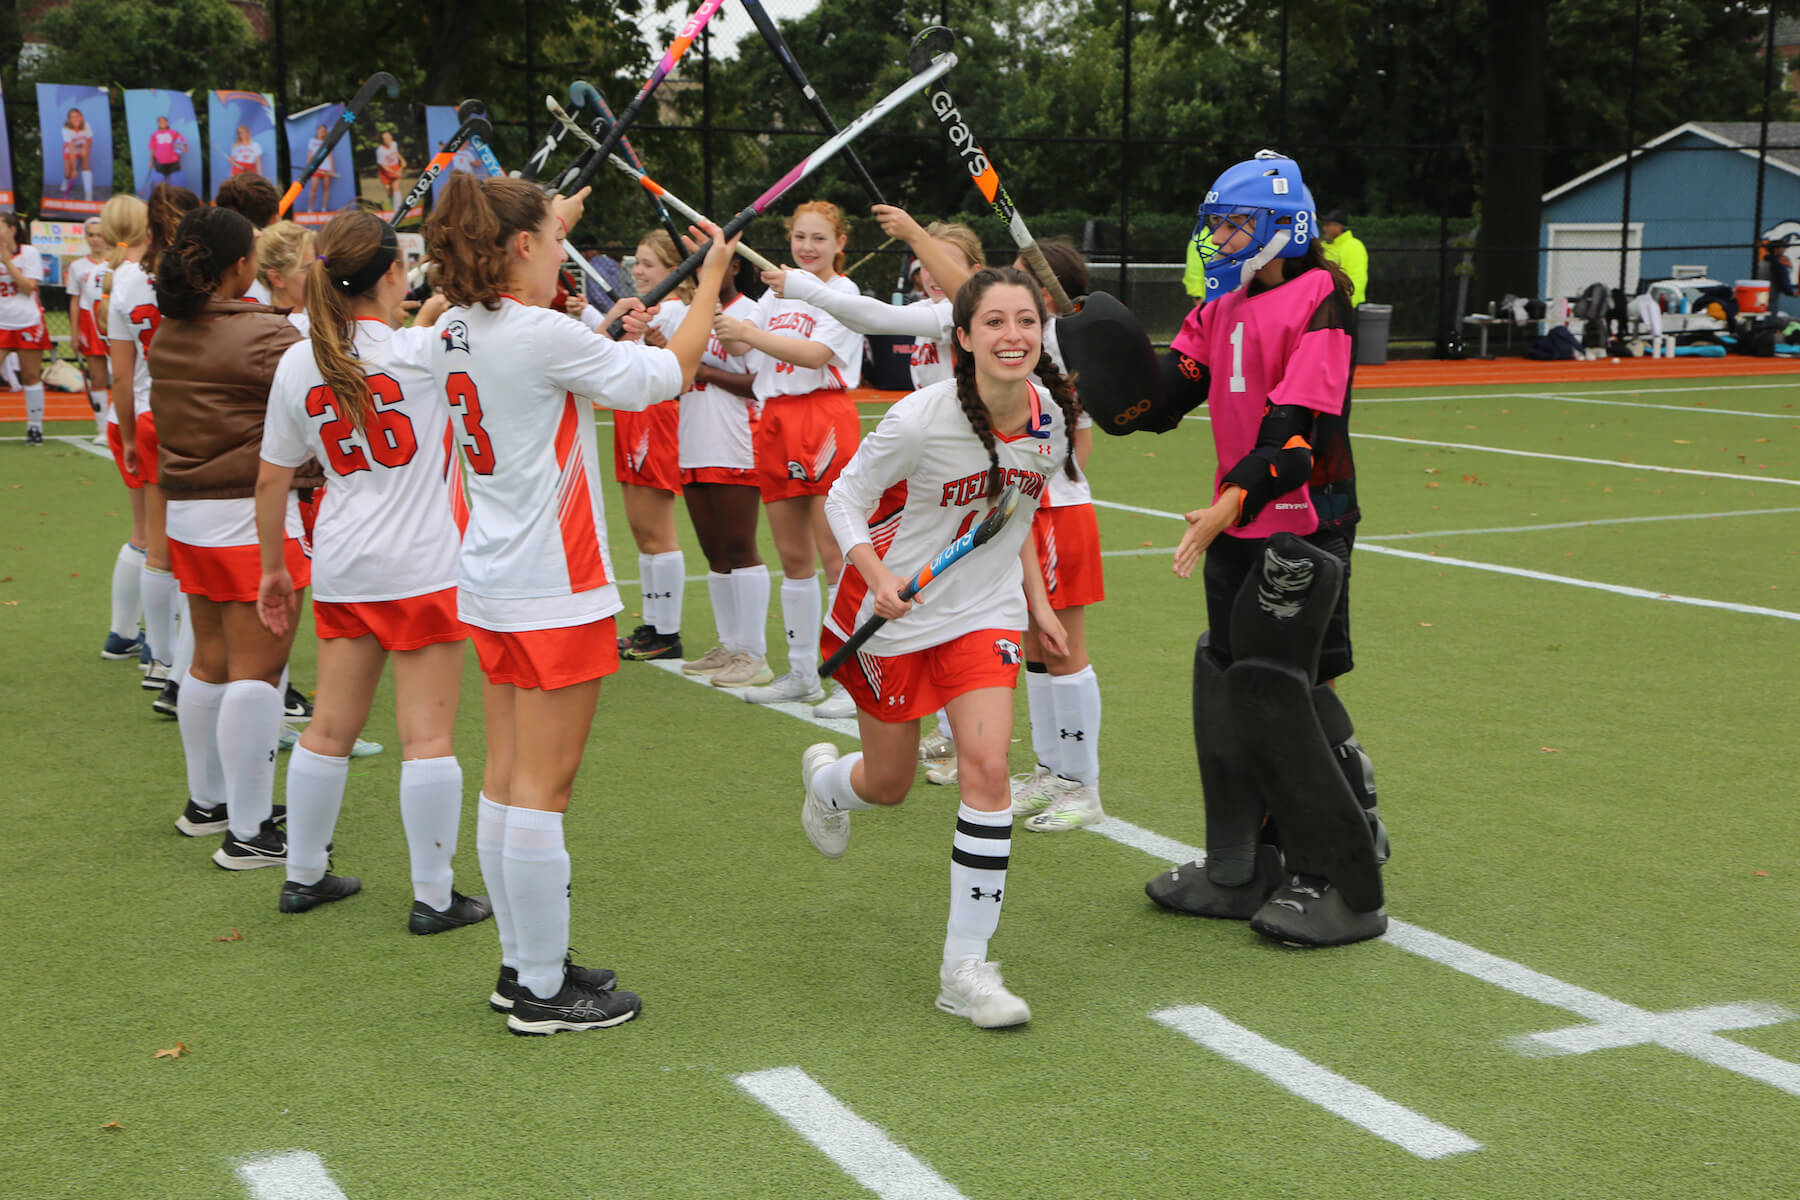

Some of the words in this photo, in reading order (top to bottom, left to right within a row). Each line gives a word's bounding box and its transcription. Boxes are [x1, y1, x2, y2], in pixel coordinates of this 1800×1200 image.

[1294, 211, 1309, 245] OBO
[1229, 322, 1246, 393] 1
[305, 372, 418, 477] 26
[445, 371, 496, 475] 3
[1114, 400, 1151, 425] OBO
